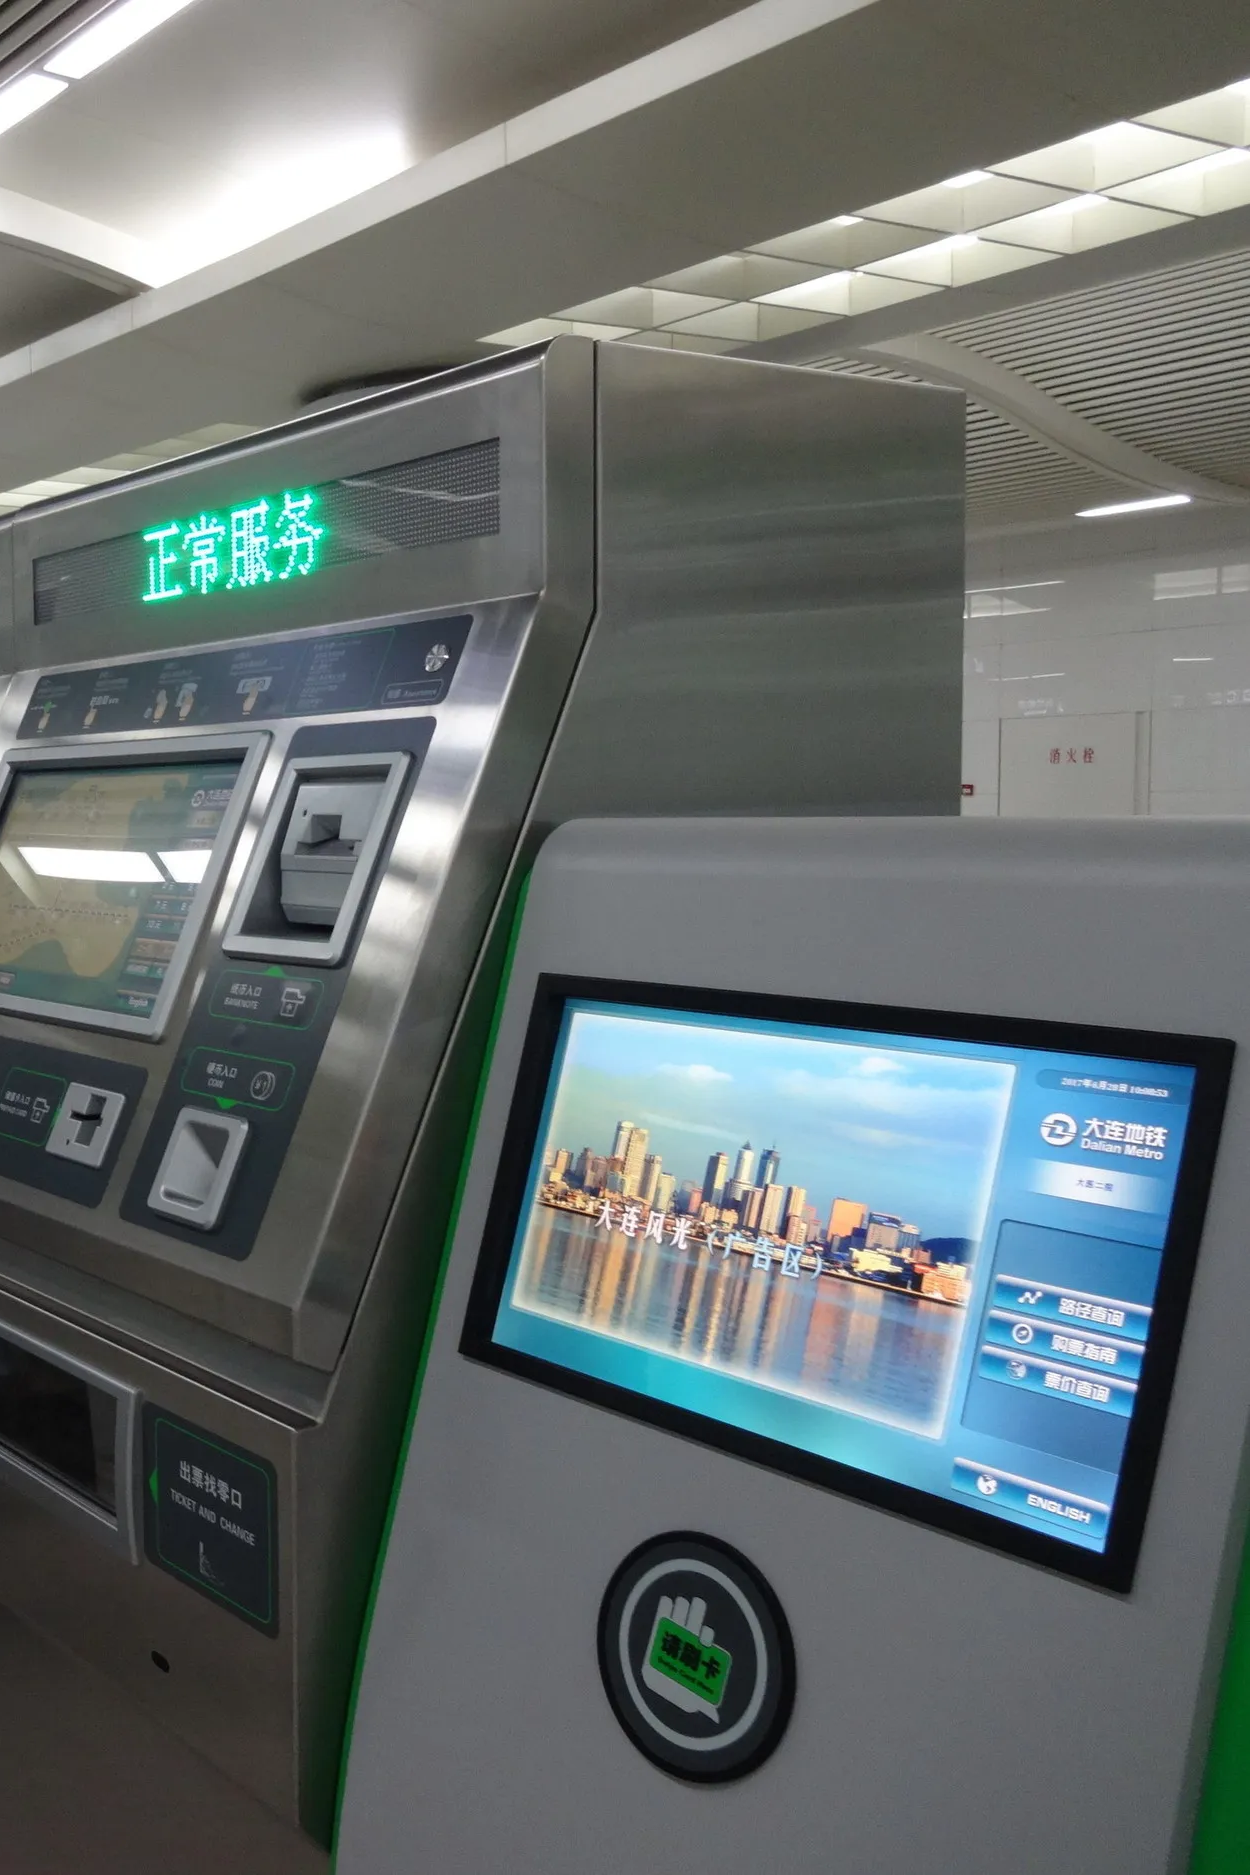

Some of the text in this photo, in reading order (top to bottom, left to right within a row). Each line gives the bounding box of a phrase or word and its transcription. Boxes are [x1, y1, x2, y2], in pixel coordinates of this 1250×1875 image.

[141, 490, 325, 602] 正常服务
[1049, 747, 1094, 764] 消火栓
[1081, 1117, 1168, 1148] 大连地铁
[1080, 1138, 1164, 1161] Dalian Metro
[1058, 1298, 1125, 1328] 路径查询
[1051, 1334, 1118, 1365] 购票指南
[1044, 1371, 1110, 1403] 票价查询
[179, 1460, 242, 1509] 出票找零口
[170, 1488, 256, 1546] TICKET AND CHANGE
[1026, 1493, 1092, 1524] ENGLISH
